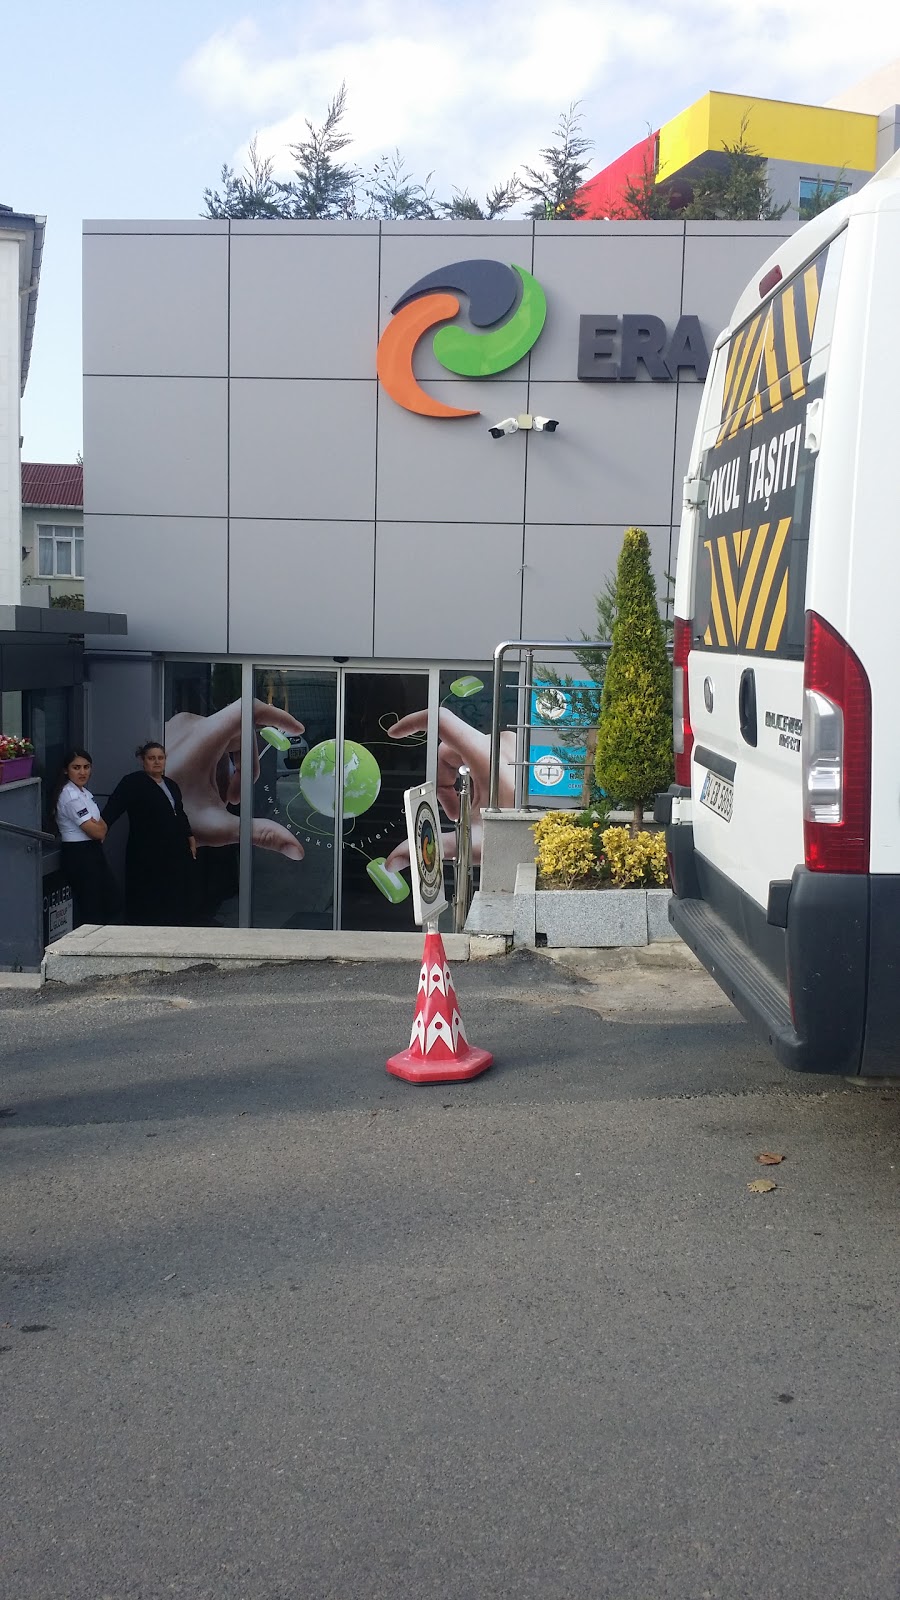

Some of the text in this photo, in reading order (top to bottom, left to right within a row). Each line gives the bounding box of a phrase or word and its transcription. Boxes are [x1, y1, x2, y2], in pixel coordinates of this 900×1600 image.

[577, 314, 709, 381] ERA
[707, 424, 802, 520] OKUL TAŞITI
